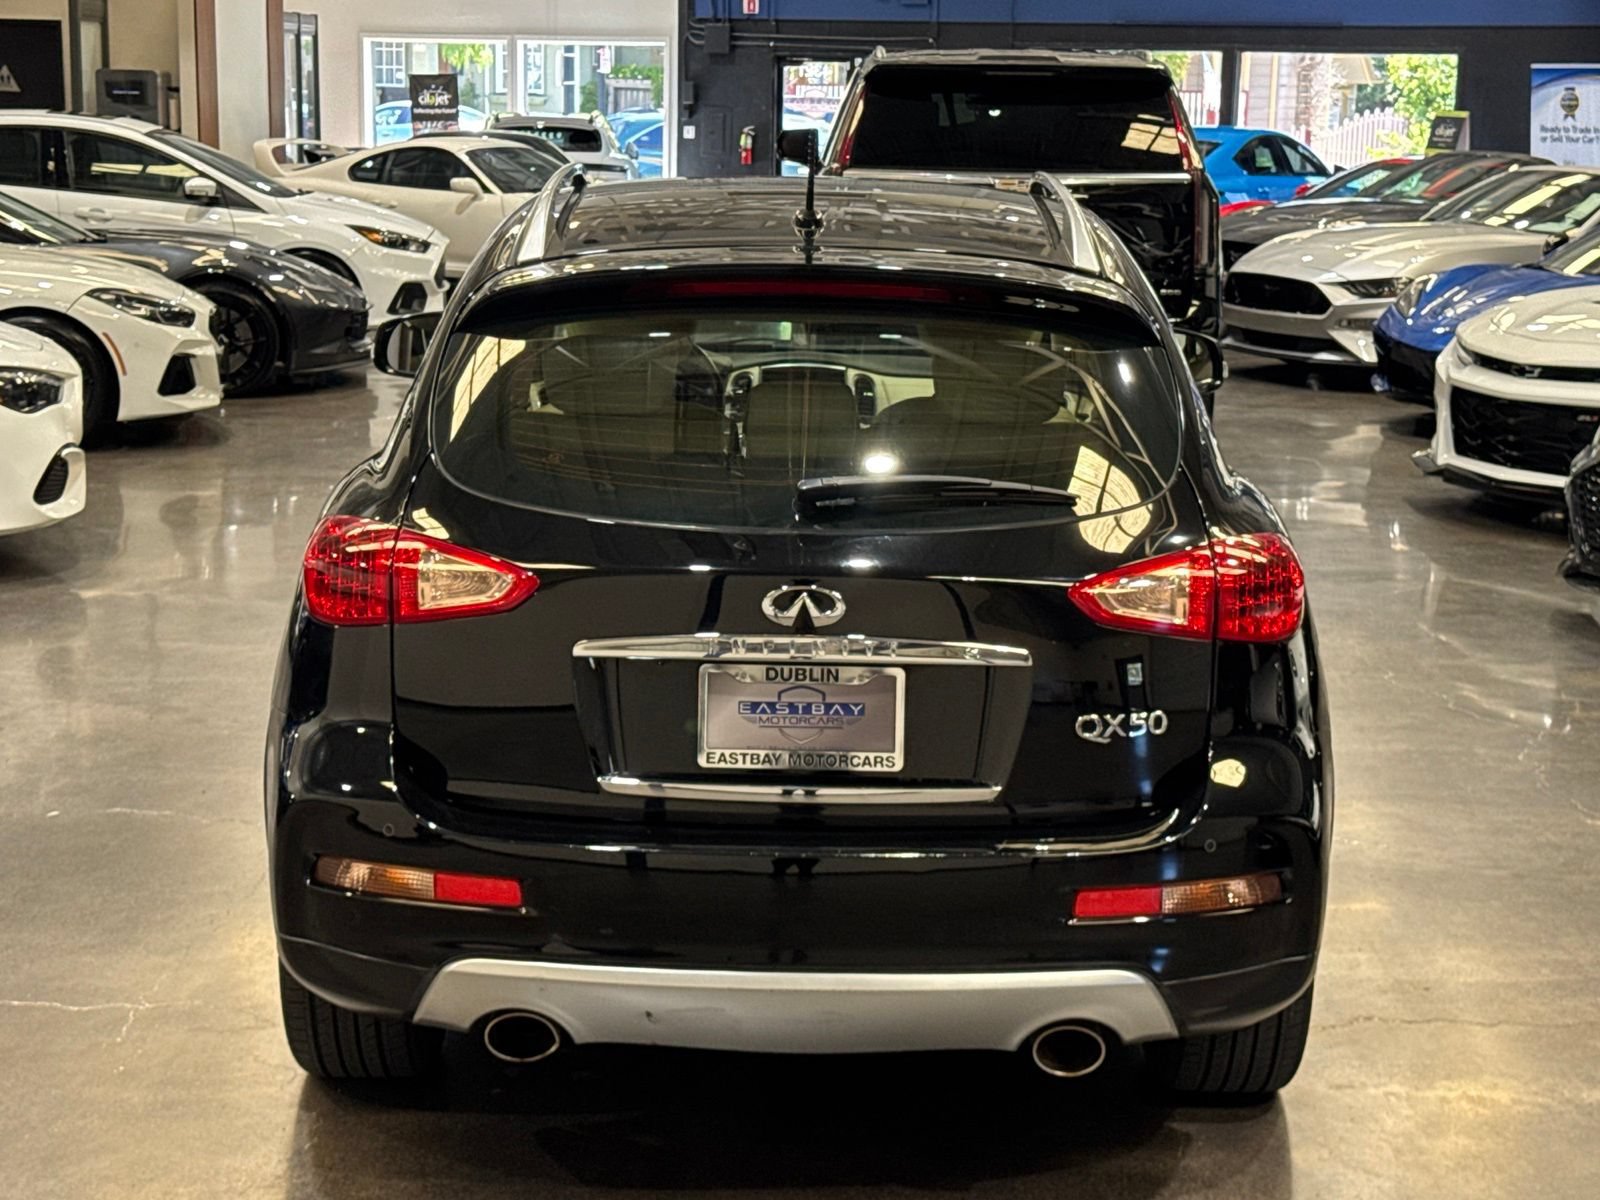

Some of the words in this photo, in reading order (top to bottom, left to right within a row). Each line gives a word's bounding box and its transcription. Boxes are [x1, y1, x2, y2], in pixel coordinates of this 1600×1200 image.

[1540, 125, 1561, 134] Ready
[1563, 125, 1570, 133] to
[1571, 125, 1591, 133] Trade
[1550, 135, 1563, 143] Sell
[1565, 135, 1581, 143] Your
[765, 667, 840, 683] DUBLIN
[739, 702, 863, 715] EASTBAY
[758, 716, 845, 726] MOTORCARS
[1075, 710, 1169, 745] QX50
[706, 752, 782, 766] EASTBAY
[787, 753, 896, 769] MOTORCARS
